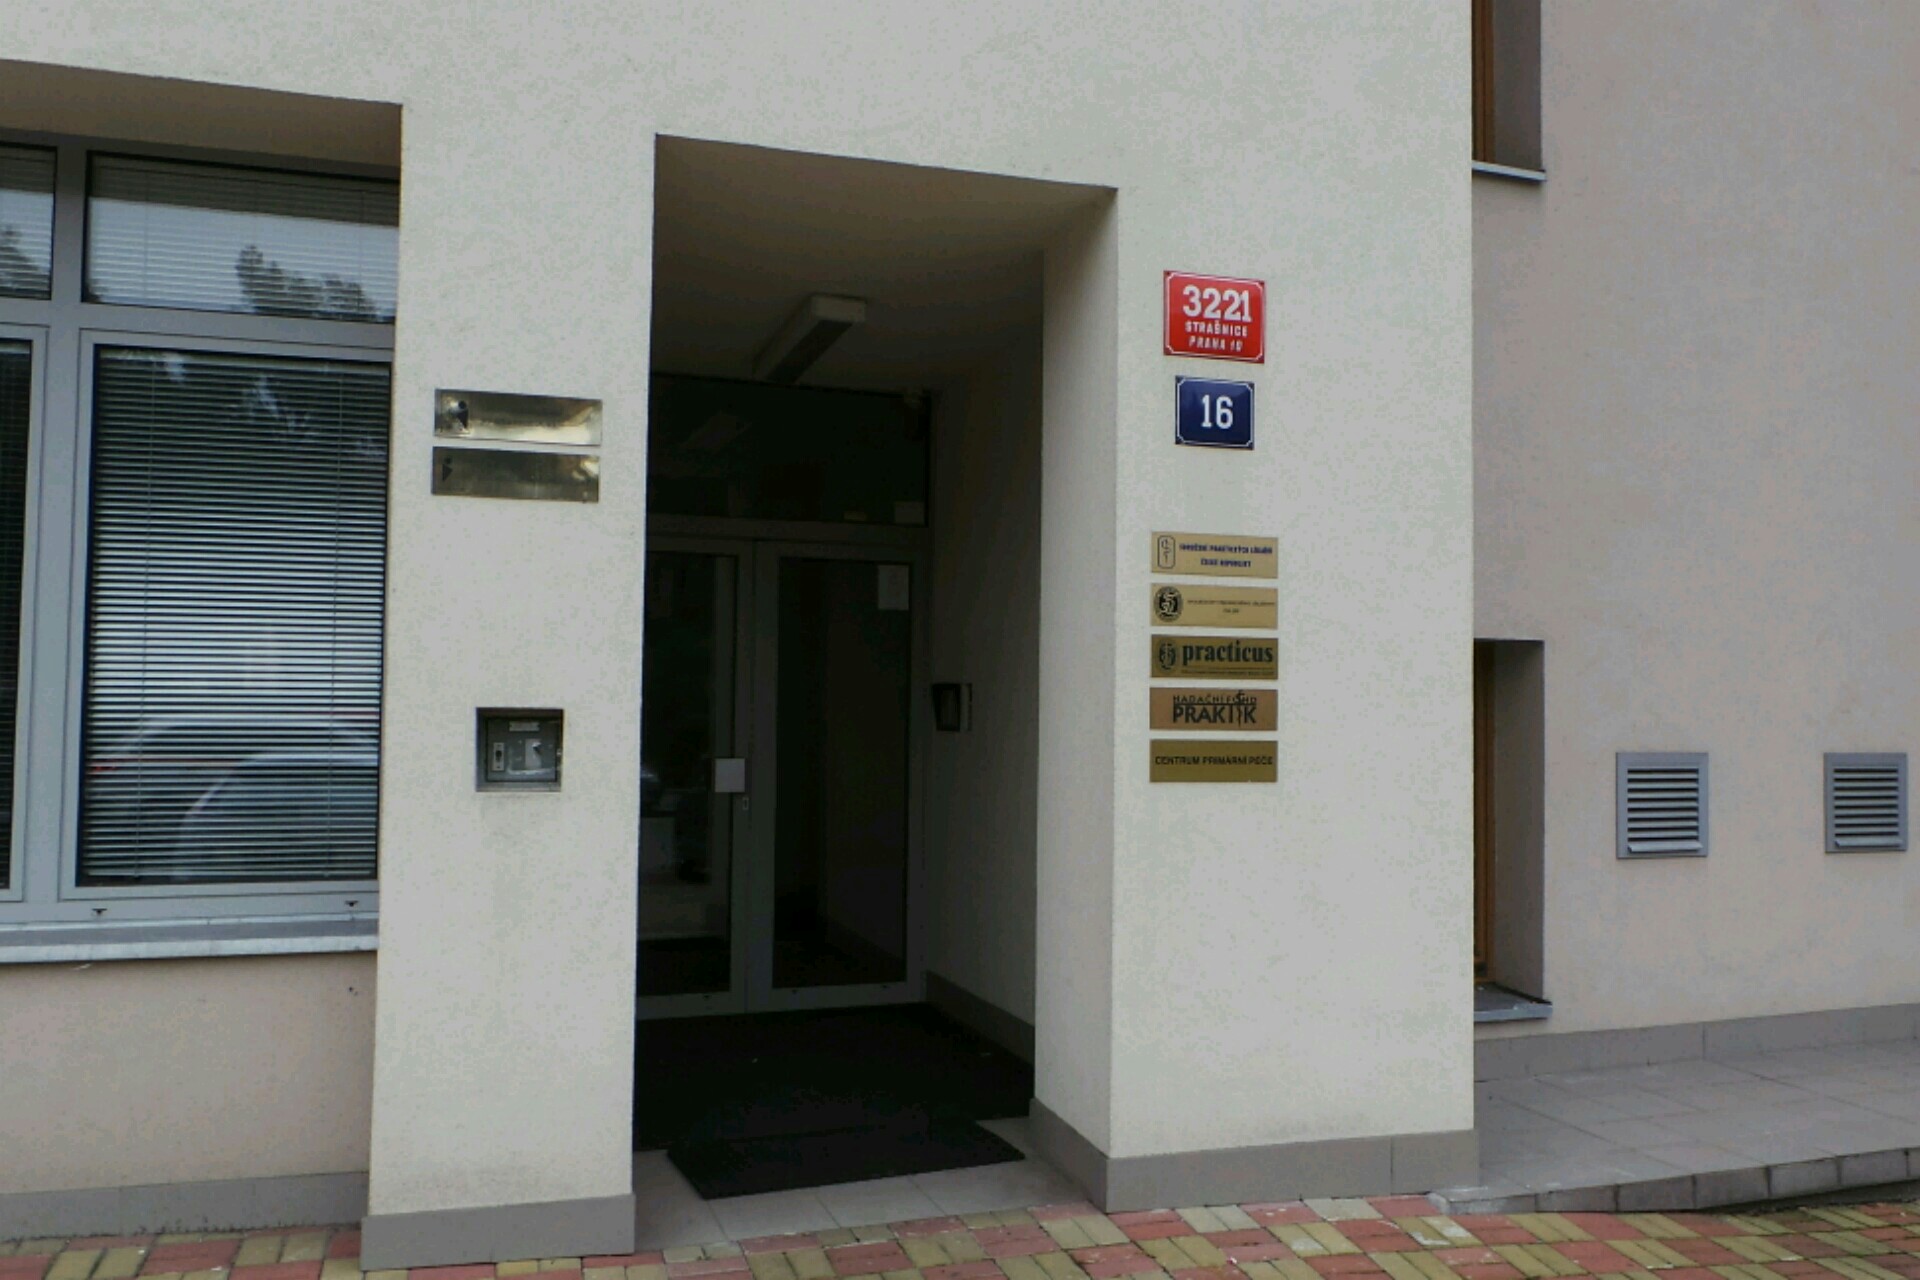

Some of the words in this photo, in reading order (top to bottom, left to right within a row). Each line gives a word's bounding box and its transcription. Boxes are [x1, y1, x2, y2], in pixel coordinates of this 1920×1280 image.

[1182, 284, 1252, 323] 3221
[1185, 320, 1249, 337] STRAŠNICE
[1188, 335, 1226, 350] PRAHA
[1230, 339, 1244, 352] 10
[1201, 394, 1234, 429] 16
[1182, 639, 1273, 666] practicus
[1173, 704, 1257, 725] PRAKTIK
[1155, 756, 1200, 765] CENTRUM
